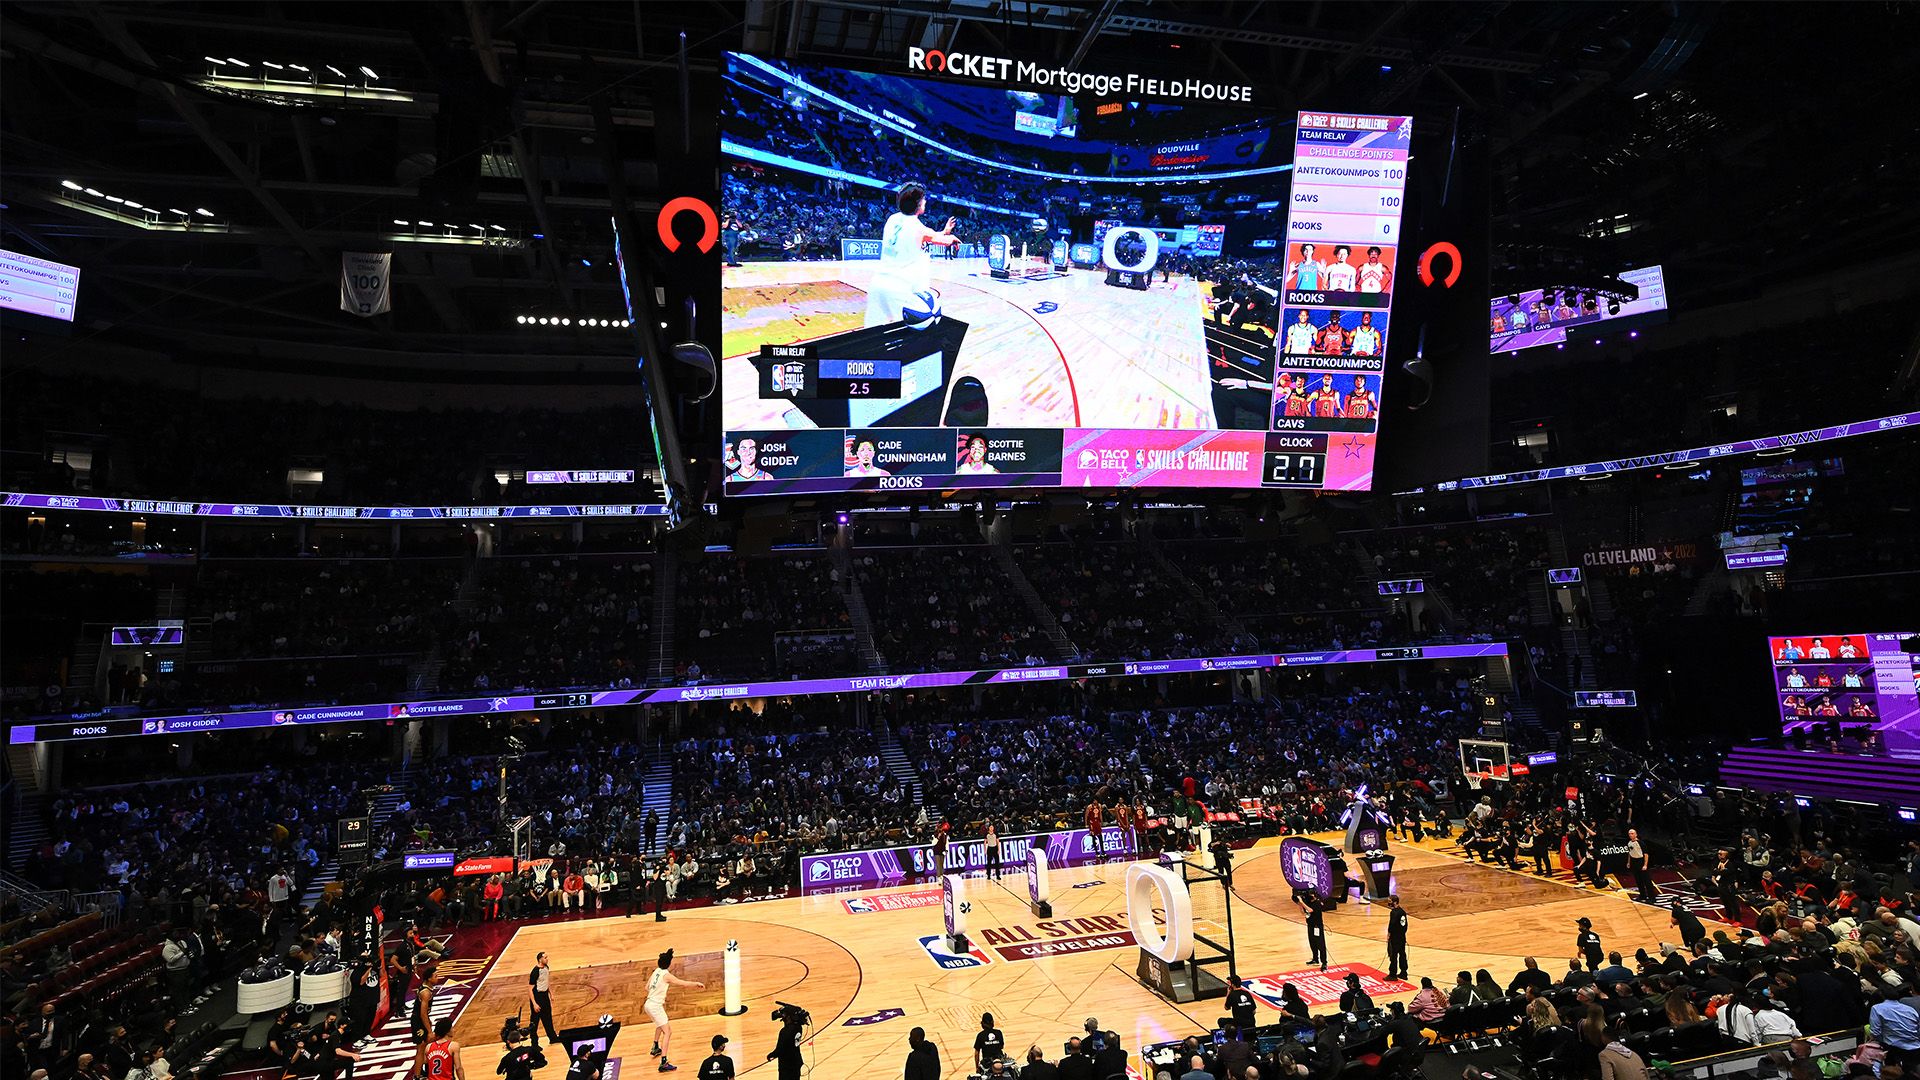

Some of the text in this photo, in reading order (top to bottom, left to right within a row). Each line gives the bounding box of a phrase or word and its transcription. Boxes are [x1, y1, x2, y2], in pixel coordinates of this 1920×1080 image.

[909, 46, 1012, 80] ROCKET
[1017, 60, 1122, 96] Mortgage
[1301, 131, 1346, 140] TEAM RELAY
[1309, 147, 1394, 159] CHALLENGE POINTS
[1297, 166, 1380, 178] ANTETOKOUNMPOS
[1383, 169, 1403, 180] 100
[1294, 193, 1319, 203] CAVS
[1380, 197, 1400, 207] 100
[1291, 221, 1323, 231] ROOKS
[1383, 224, 1390, 234] 0
[861, 242, 879, 250] TACO
[60, 276, 74, 285] 100
[352, 275, 380, 289] 100
[57, 291, 72, 299] 100
[1288, 293, 1325, 303] ROOKS
[772, 347, 805, 357] TEAM RELAY
[1282, 357, 1381, 369] ANTETOKOUNMPOS
[846, 362, 874, 376] ROOKS
[849, 383, 870, 395] 2.5
[1277, 419, 1305, 429] CAVS
[877, 440, 902, 450] CADE
[987, 439, 1024, 449] SCOTTIE
[1280, 438, 1313, 447] CLOCK
[760, 443, 786, 453] JOSH
[877, 452, 946, 464] CUNNINGHAM
[987, 451, 1026, 462] BARNES
[1100, 449, 1129, 459] TACO
[760, 455, 799, 467] GIDDEY
[1101, 459, 1128, 469] BELL
[1147, 450, 1249, 471] SKILLS CHALLENGE
[1273, 455, 1315, 481] 2.7
[579, 471, 628, 481] SKILLS CHALLENGE
[879, 476, 923, 489] ROOKS
[130, 501, 193, 514] SKILLS CHALLENGE
[302, 507, 357, 518] SKILLS CHALLENGE
[450, 507, 500, 517] SKILLS CHALLENGE
[586, 506, 632, 515] SKILLS CHALLENGE
[1583, 543, 1697, 566] CLEVELAND 2022
[1403, 648, 1419, 657] 2.8
[850, 677, 907, 689] TEAM RELAY
[724, 686, 748, 696] CHALLENGE
[568, 694, 587, 706] 2.8
[438, 704, 463, 712] BARNES
[317, 710, 364, 719] CUNNINGHAM
[170, 719, 220, 729] JOSH GIDDEY
[73, 726, 107, 736] ROOKS
[347, 821, 360, 830] 2.9
[926, 839, 1032, 871] SILLS CHLENGE
[830, 857, 862, 869] TACO
[834, 867, 863, 879] BELL
[364, 916, 373, 940] NBA
[981, 915, 1128, 945] ALL STAR
[1023, 935, 1126, 955] CLEVELAND
[944, 957, 972, 968] NBA
[432, 1058, 443, 1075] 2
